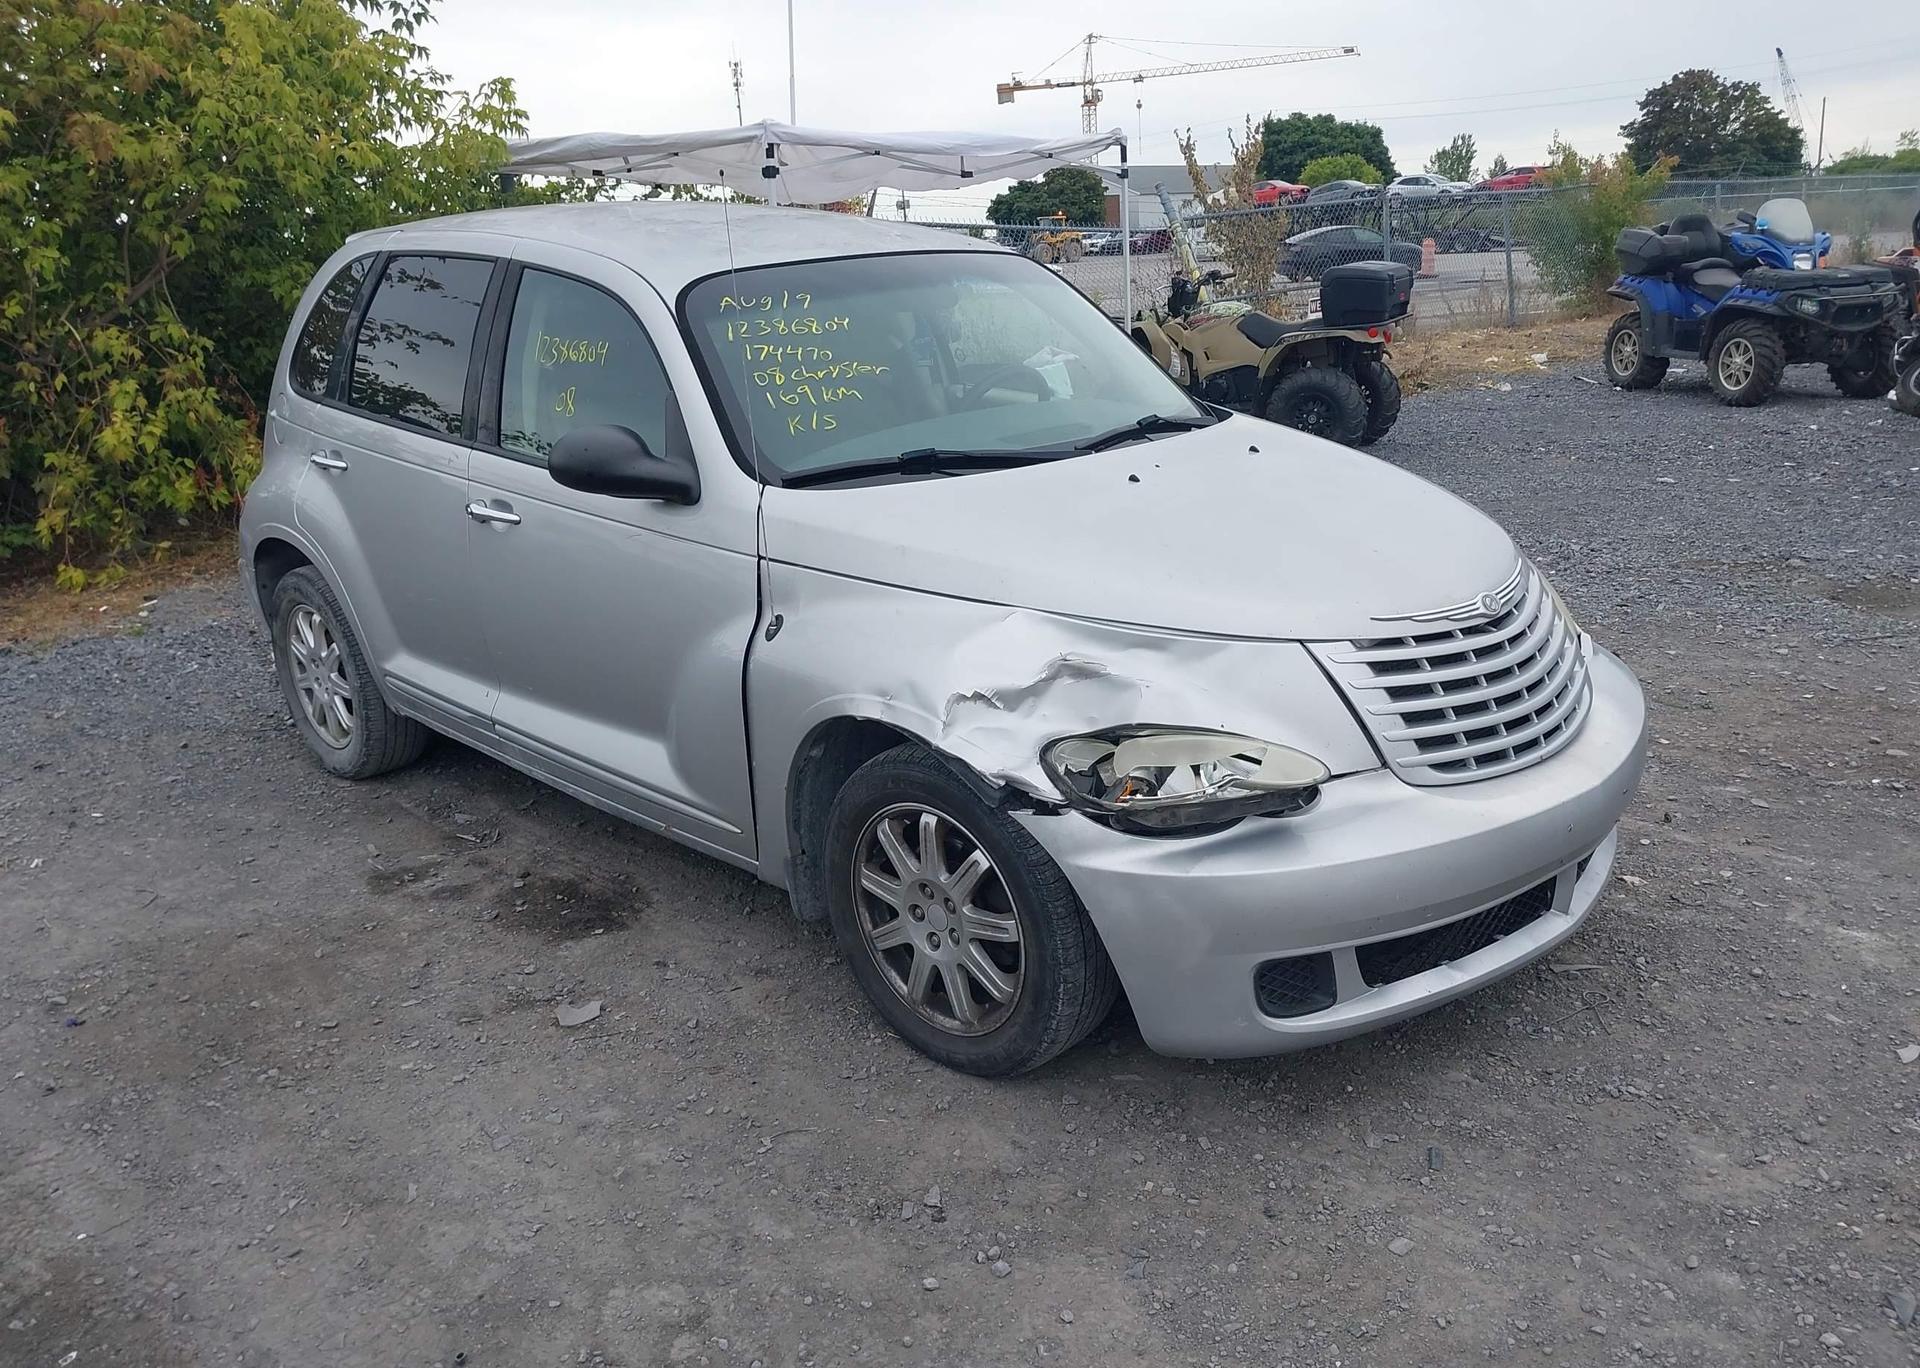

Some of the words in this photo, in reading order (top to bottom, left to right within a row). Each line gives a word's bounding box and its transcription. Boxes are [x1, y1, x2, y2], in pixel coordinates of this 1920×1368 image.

[719, 295, 772, 313] Aug
[783, 290, 811, 310] 19
[727, 316, 850, 342] 12386804
[535, 330, 609, 367] 12386804
[745, 343, 833, 363] 174470
[753, 366, 785, 386] 08
[555, 386, 577, 417] 08
[766, 385, 817, 409] 169
